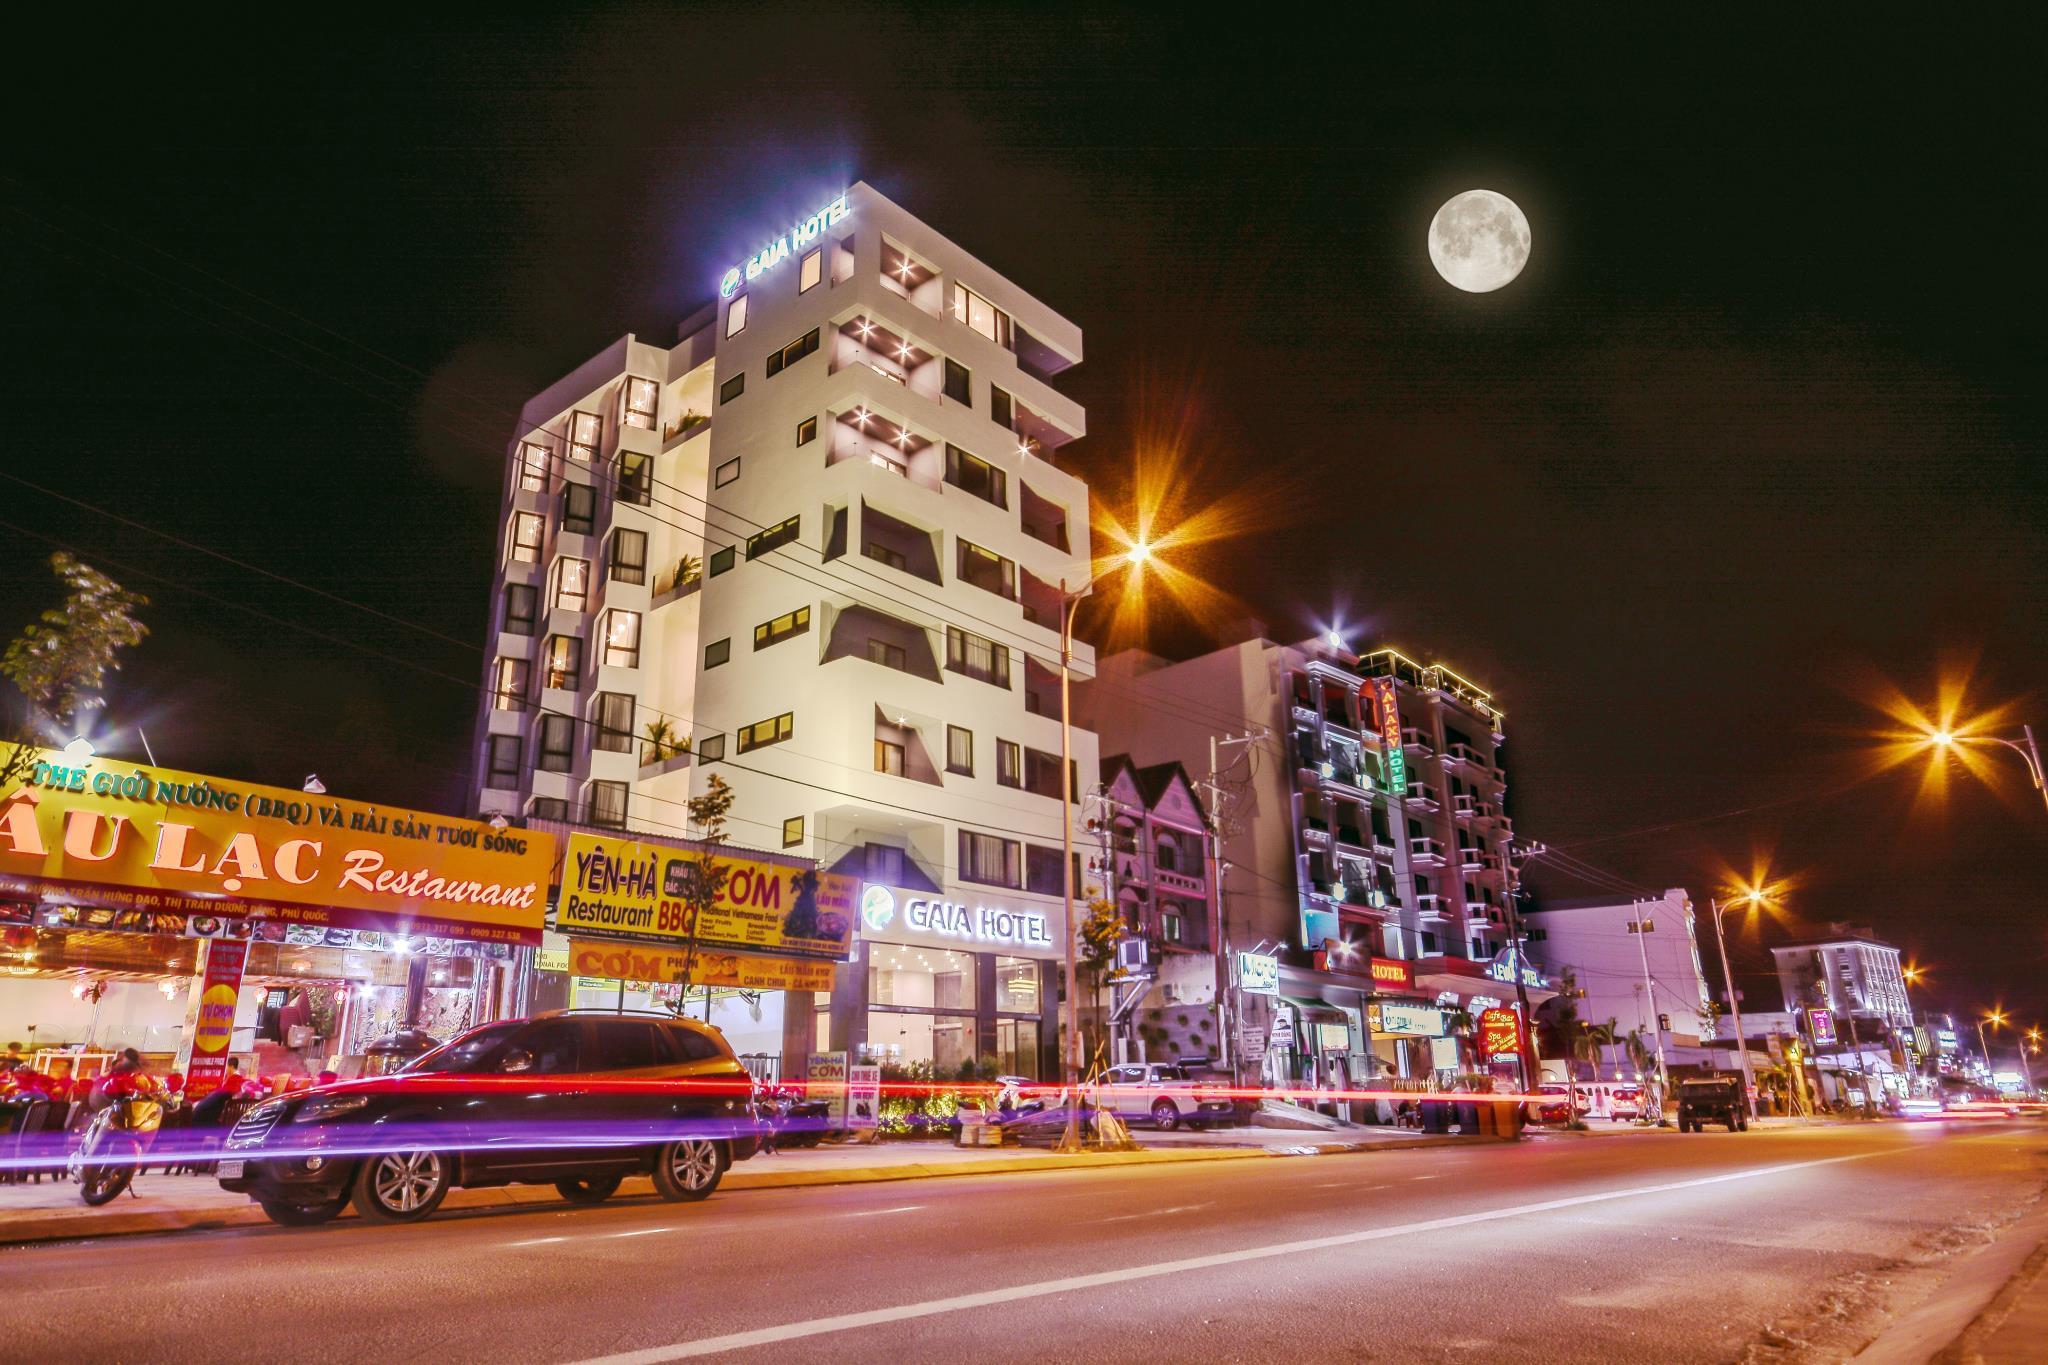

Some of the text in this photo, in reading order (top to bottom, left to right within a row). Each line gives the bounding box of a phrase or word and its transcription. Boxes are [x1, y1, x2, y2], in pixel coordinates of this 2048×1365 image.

[746, 196, 850, 280] GAIA HOTEL
[1389, 749, 1405, 793] HOTEL
[318, 803, 345, 828] VÀ
[148, 821, 323, 892] LẠC
[338, 849, 538, 909] Restaurant
[566, 894, 654, 928] Restaurant
[908, 900, 1051, 944] GAIA HOTEL
[1372, 964, 1406, 981] HOTEL
